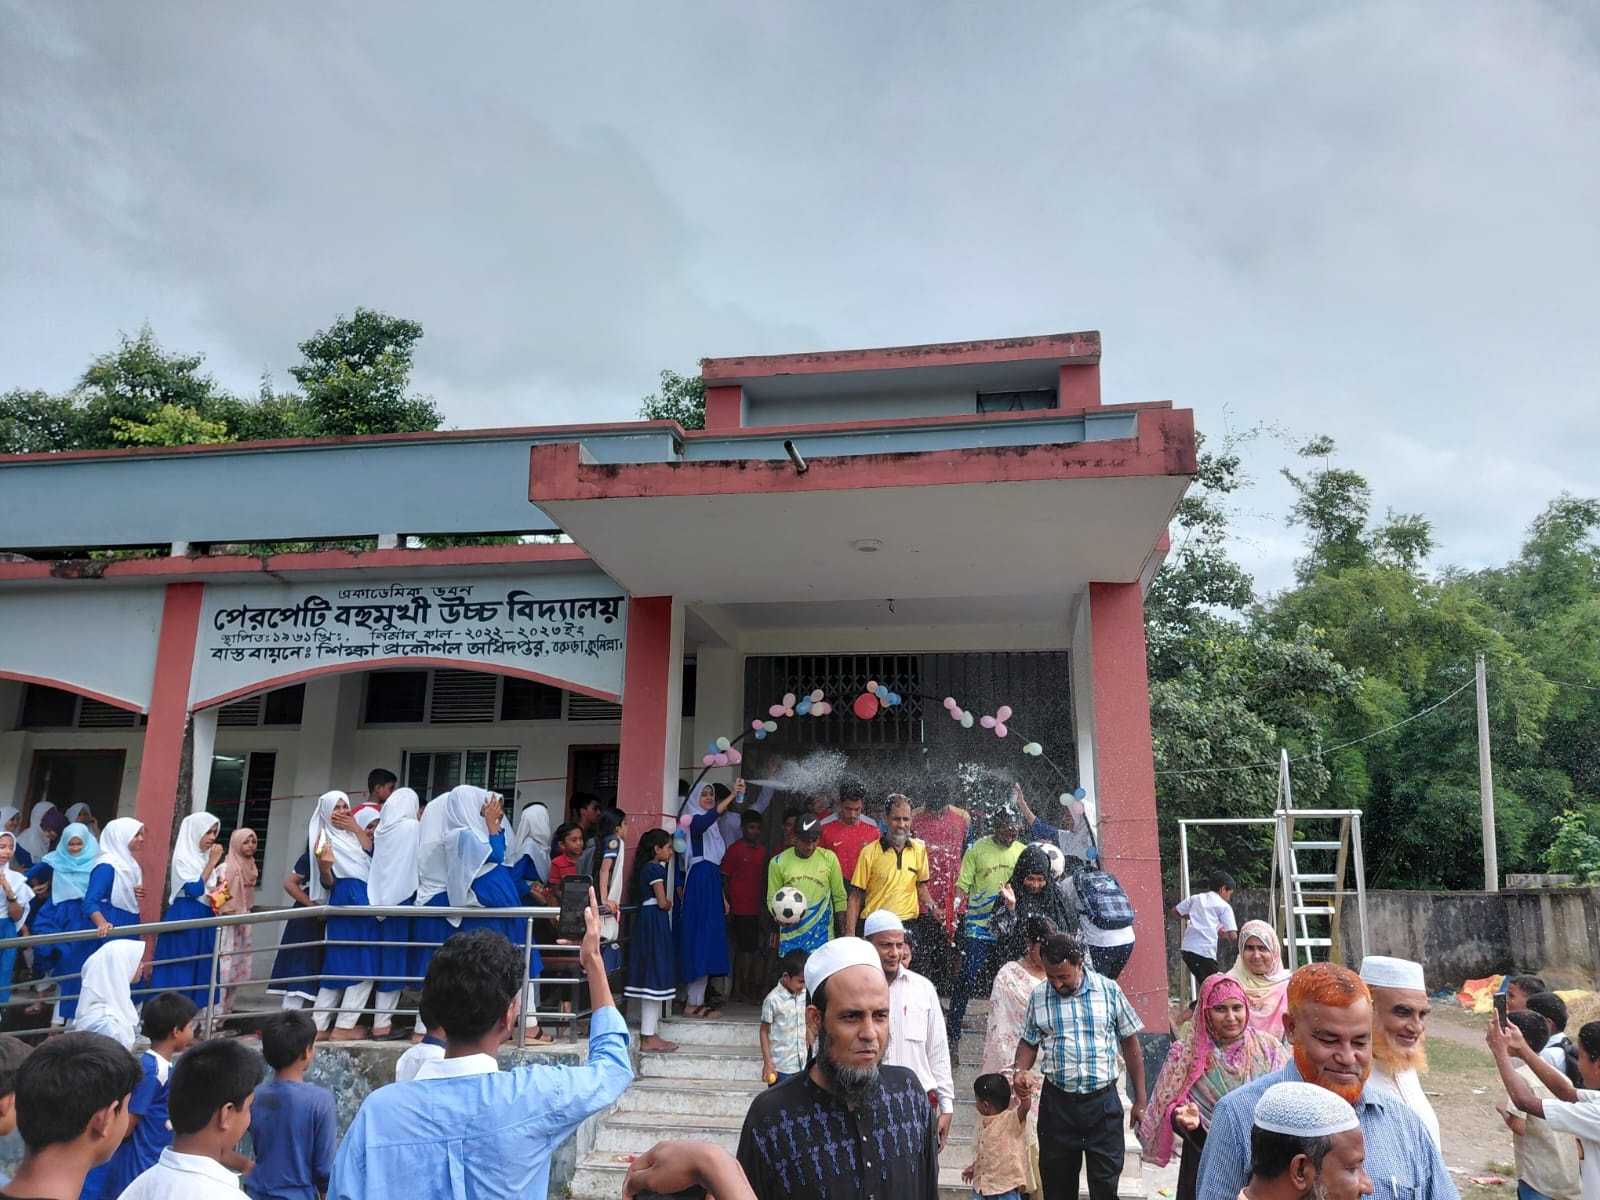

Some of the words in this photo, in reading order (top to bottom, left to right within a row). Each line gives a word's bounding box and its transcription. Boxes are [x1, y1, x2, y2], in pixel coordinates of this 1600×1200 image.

[338, 583, 423, 599] একাডেমিক
[429, 585, 475, 597] ভবন
[334, 596, 432, 631] বহুমুখী
[438, 596, 503, 624] উচ্চ
[507, 590, 625, 624] বিদ্যালয়
[424, 627, 453, 639] কাল
[315, 642, 380, 659] শিক্ষা
[383, 639, 463, 656] প্রকৌশল
